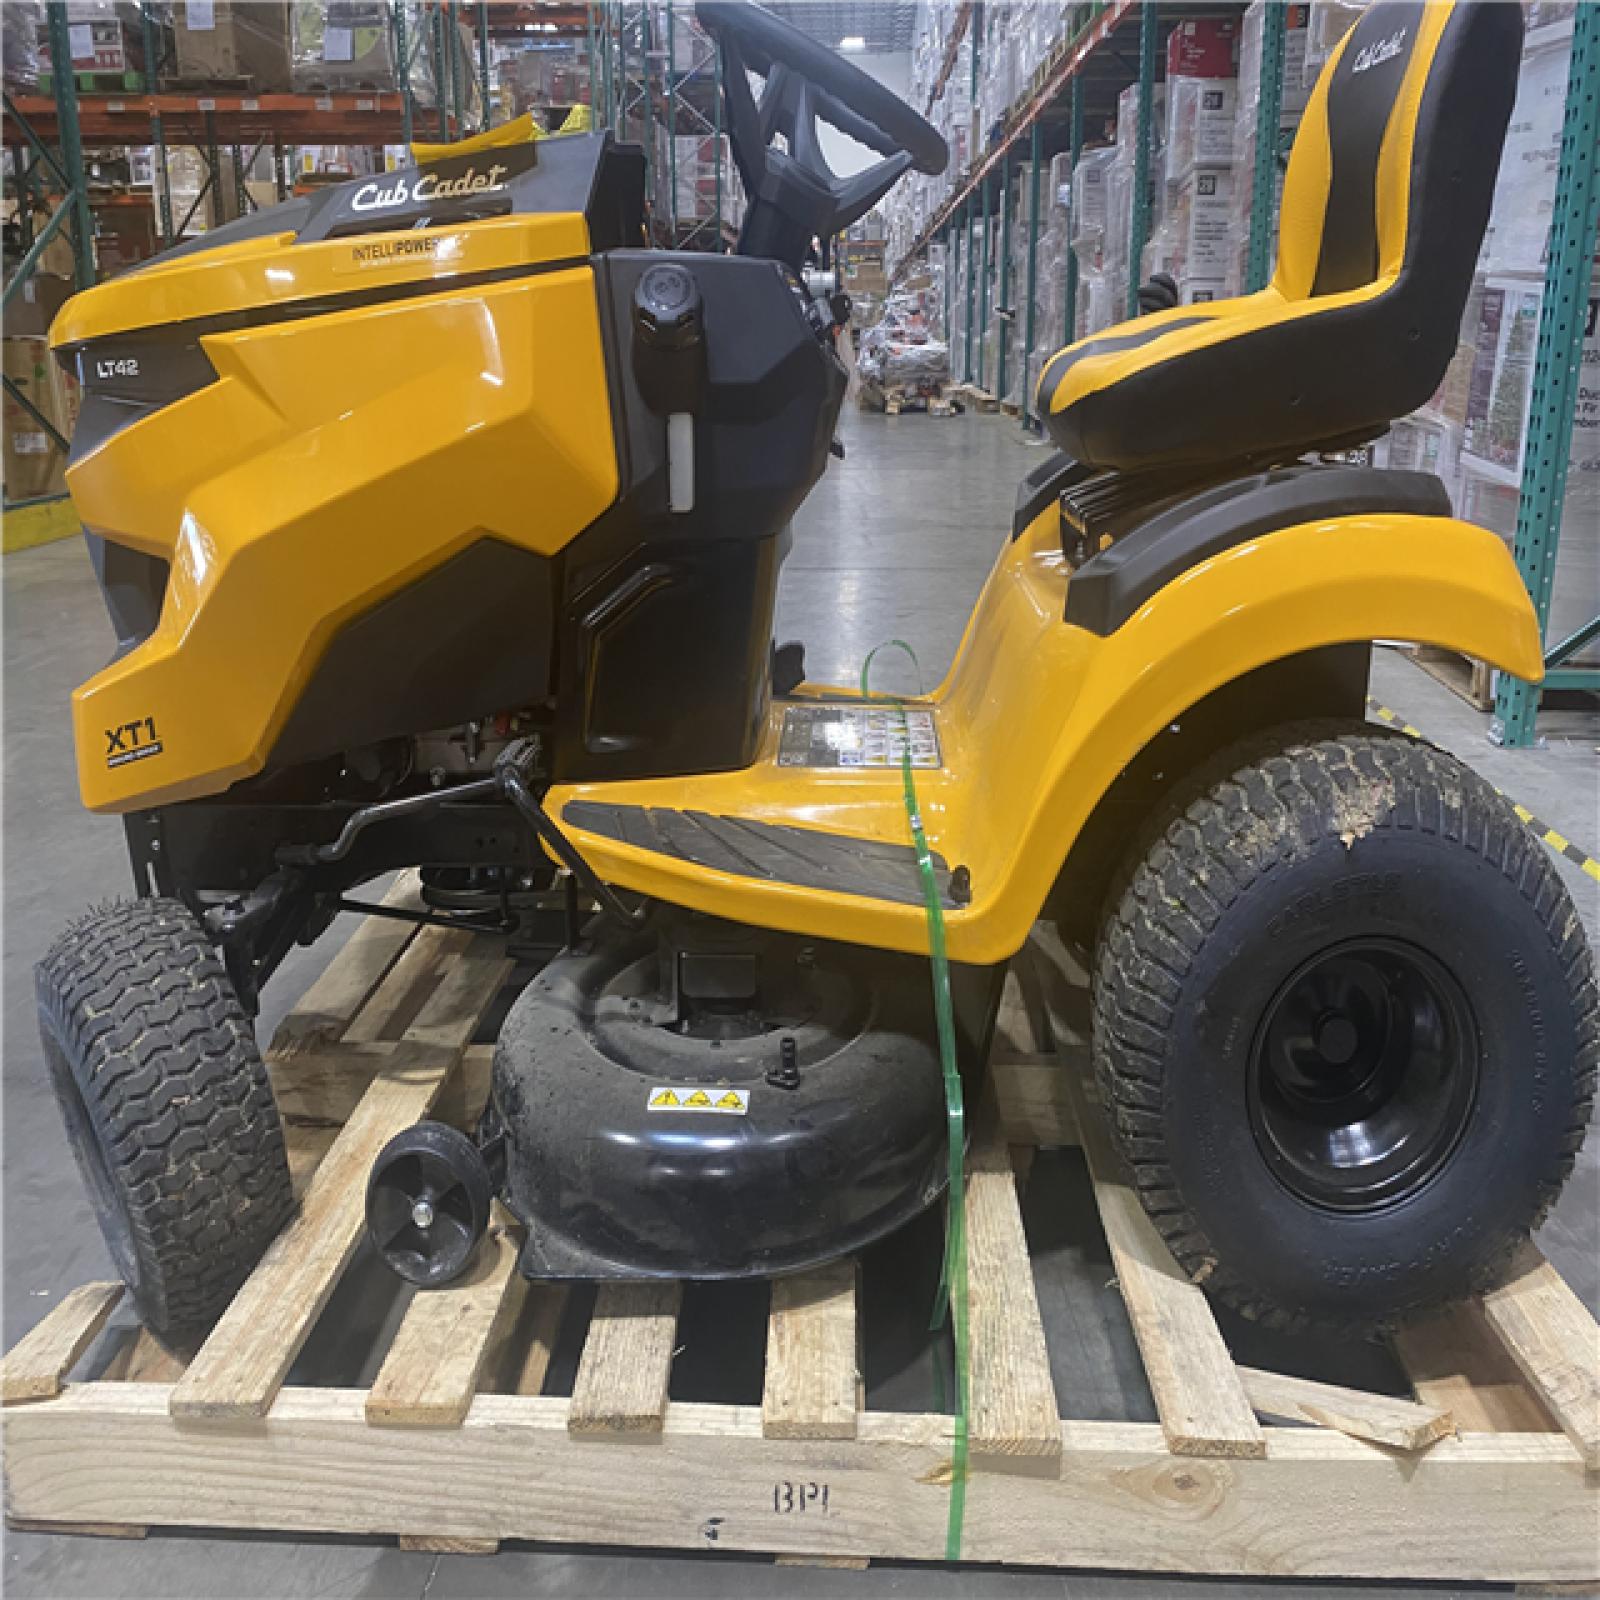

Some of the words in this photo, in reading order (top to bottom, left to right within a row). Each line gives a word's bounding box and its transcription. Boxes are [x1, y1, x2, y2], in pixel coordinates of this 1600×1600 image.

[352, 179, 408, 211] Cub
[412, 164, 508, 201] Cadet
[97, 359, 140, 379] LT42
[104, 716, 157, 754] XT1
